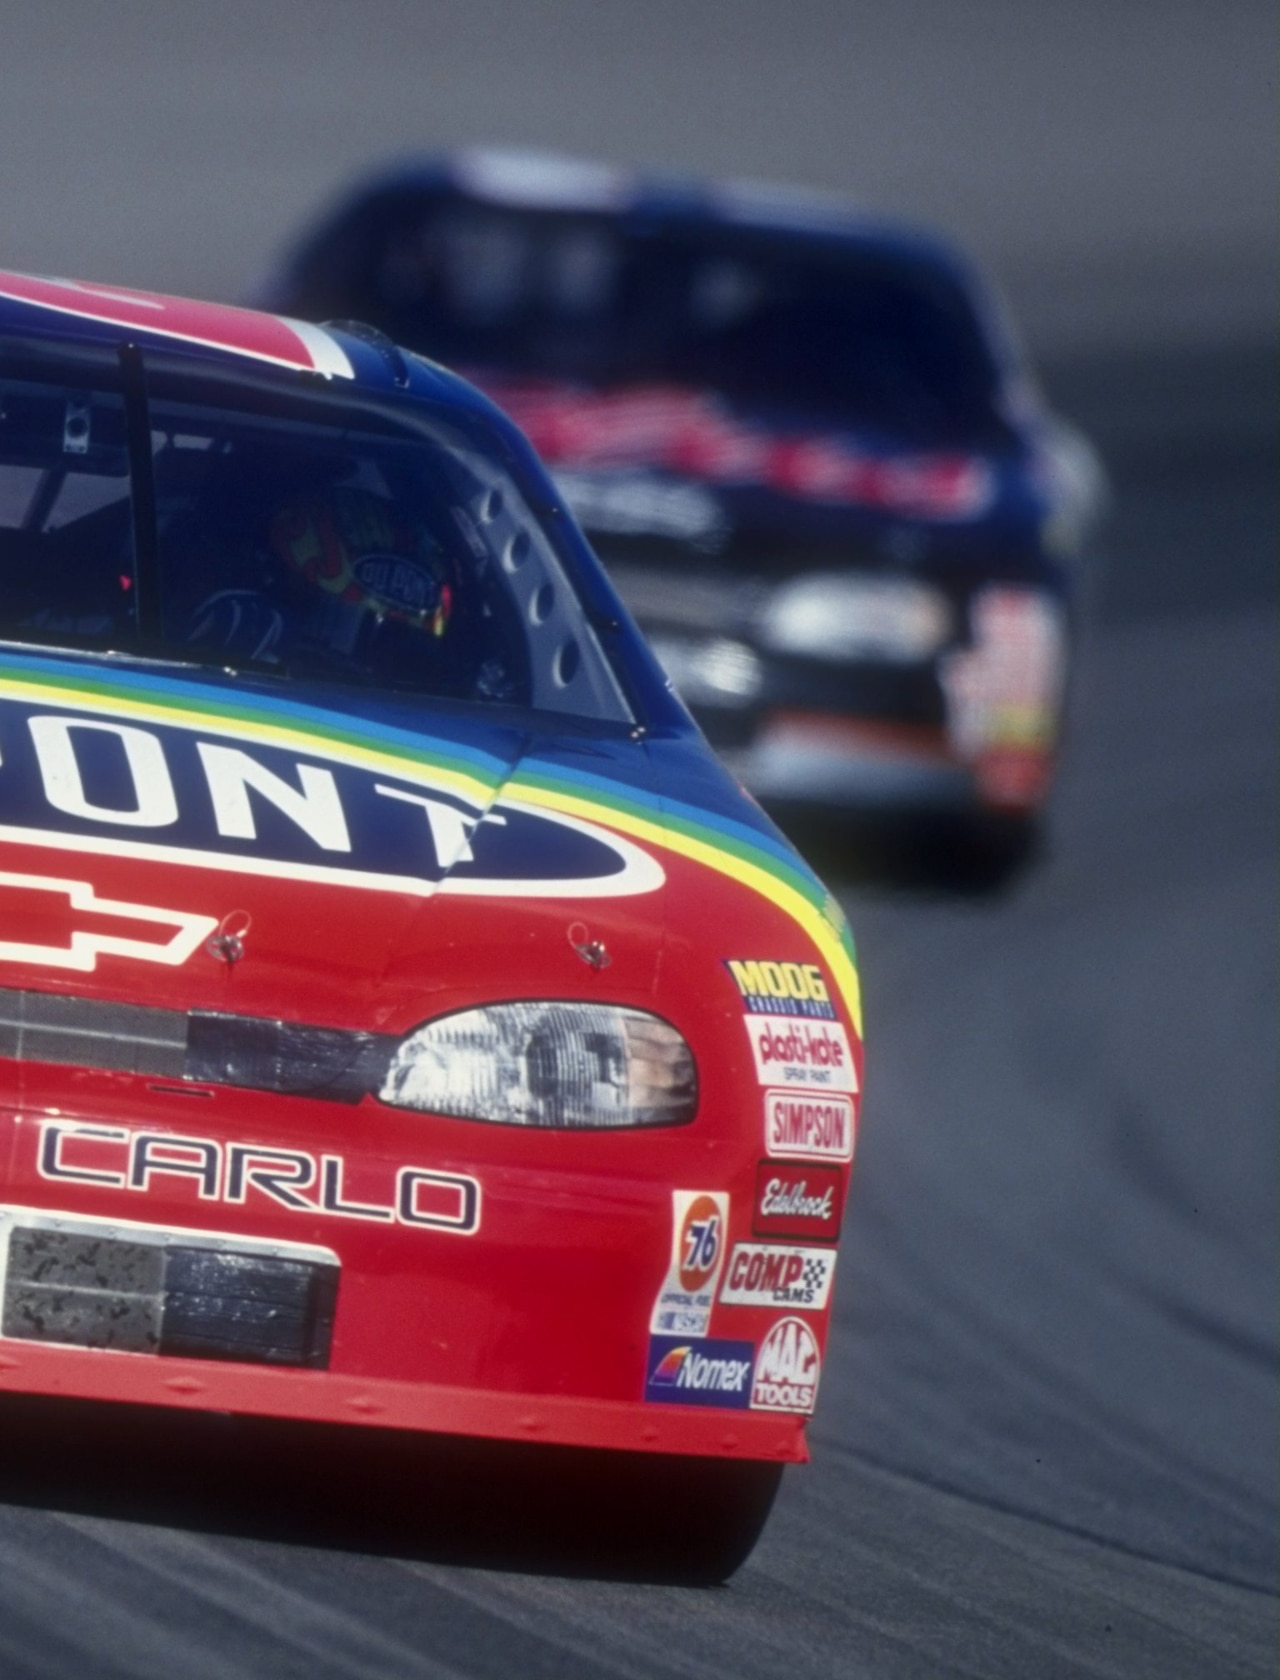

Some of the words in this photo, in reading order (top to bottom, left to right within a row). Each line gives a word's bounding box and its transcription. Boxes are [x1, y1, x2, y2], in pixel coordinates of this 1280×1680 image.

[727, 960, 830, 1002] MOOG
[759, 1021, 843, 1067] plasti-kote
[773, 1101, 845, 1149] SIMPSON
[36, 1117, 481, 1235] CARLO
[760, 1178, 834, 1220] Edelbrock
[683, 1217, 719, 1270] 76
[729, 1251, 804, 1292] COMP
[773, 1287, 815, 1304] CAMS
[676, 1352, 750, 1392] Nomex
[756, 1322, 817, 1386] MAC
[755, 1383, 813, 1407] TOOLS
